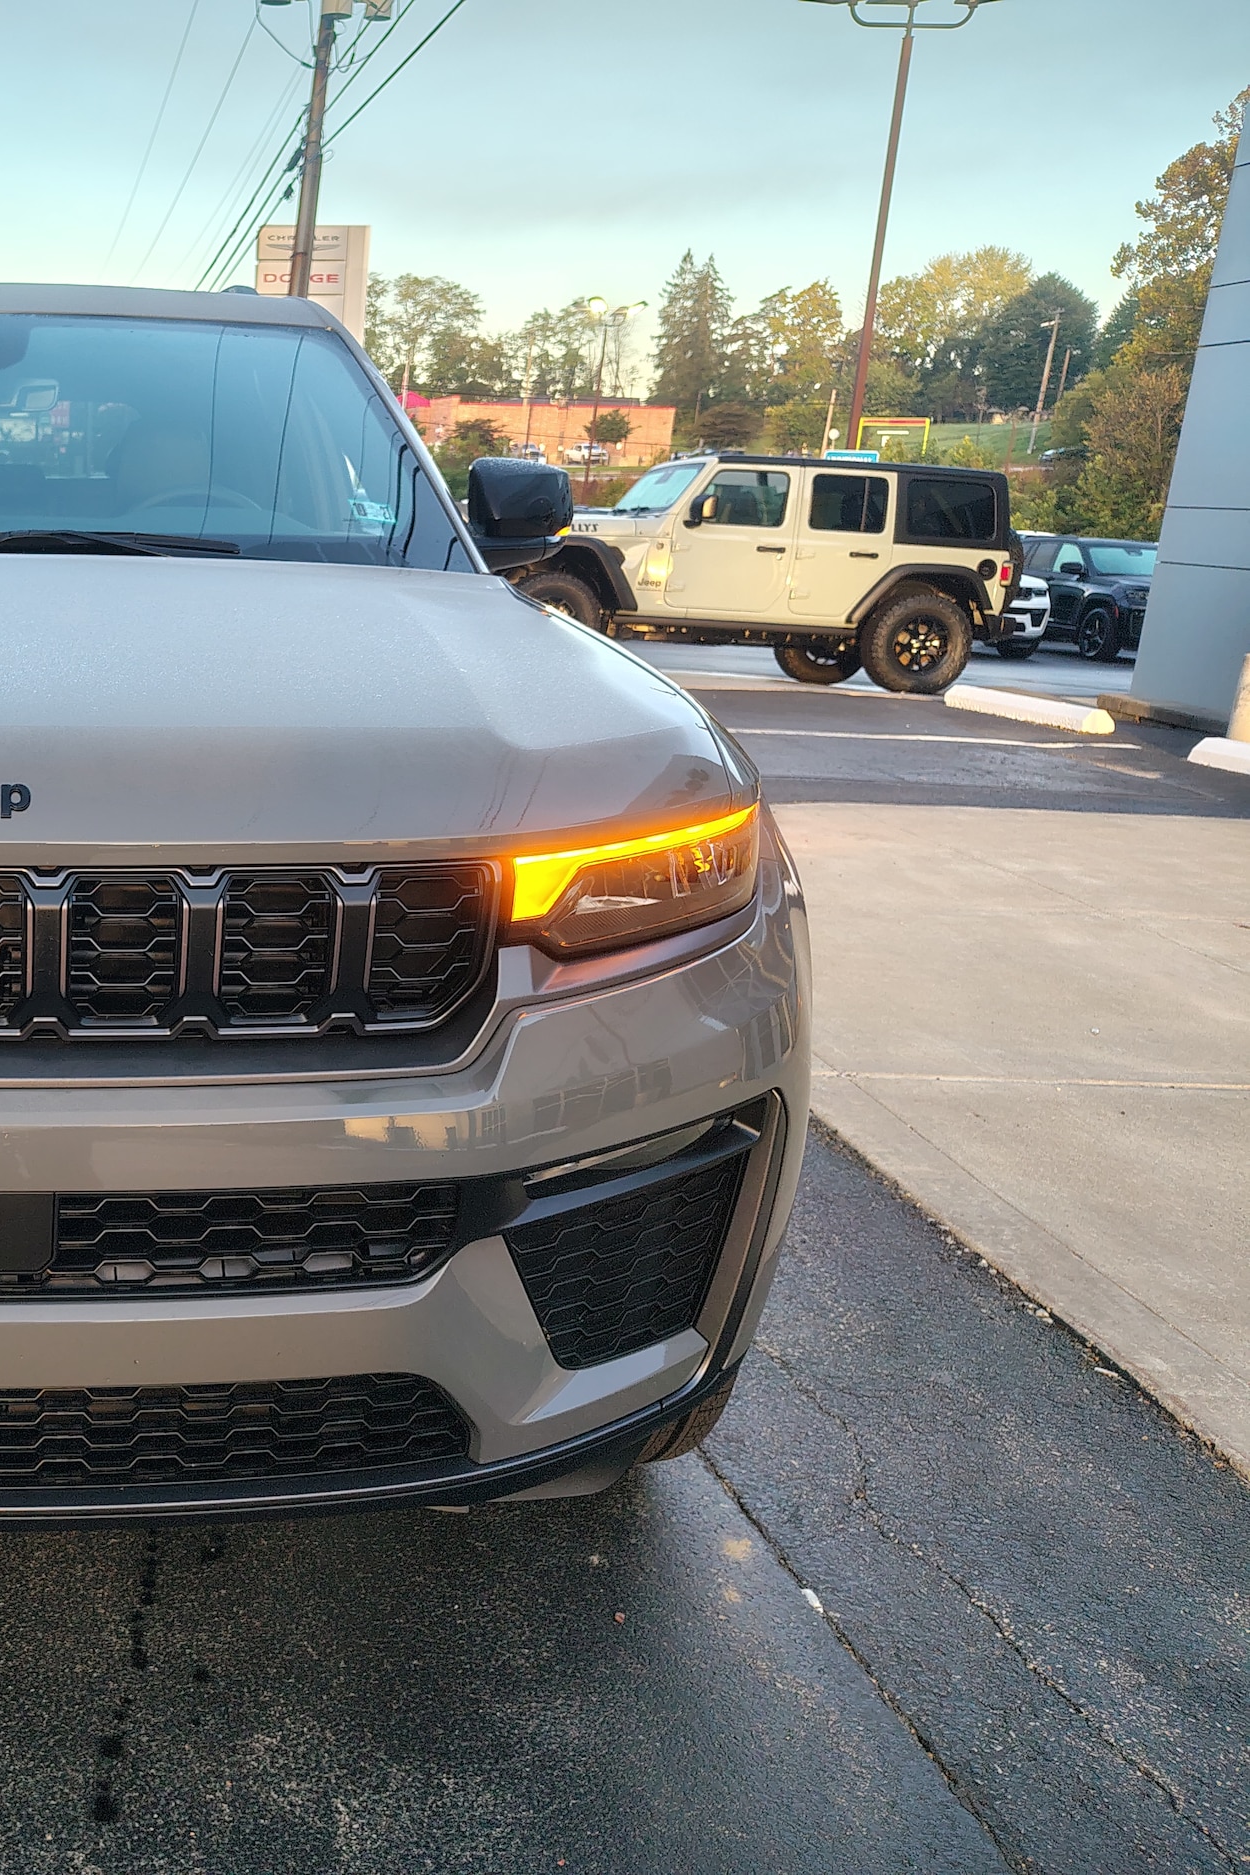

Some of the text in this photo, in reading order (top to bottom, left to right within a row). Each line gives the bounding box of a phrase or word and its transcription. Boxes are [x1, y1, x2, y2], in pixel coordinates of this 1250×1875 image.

[267, 234, 340, 242] CHRLER
[263, 273, 339, 283] DOGE
[571, 523, 599, 532] LLYS
[637, 578, 662, 588] Jeep
